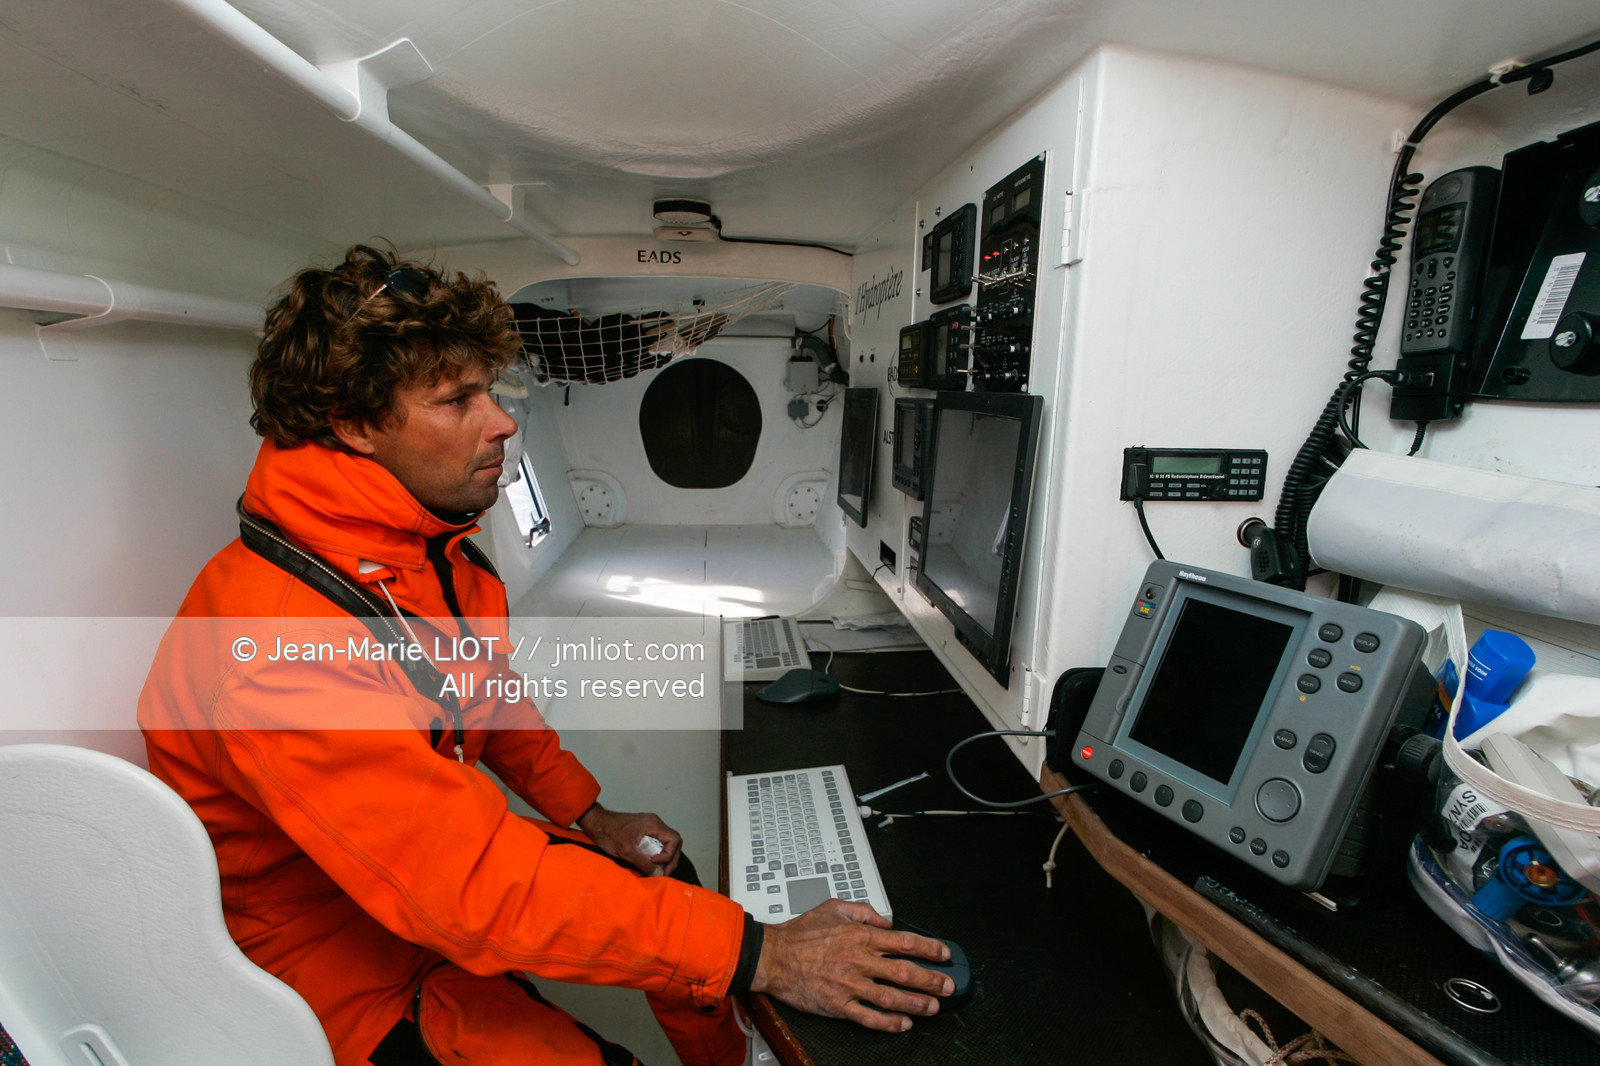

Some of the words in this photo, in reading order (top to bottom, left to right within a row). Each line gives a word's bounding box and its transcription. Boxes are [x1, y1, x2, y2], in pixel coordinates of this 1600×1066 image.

[637, 249, 682, 264] EADS
[1179, 570, 1206, 581] Raytheon
[1355, 638, 1376, 648] DISPLAY
